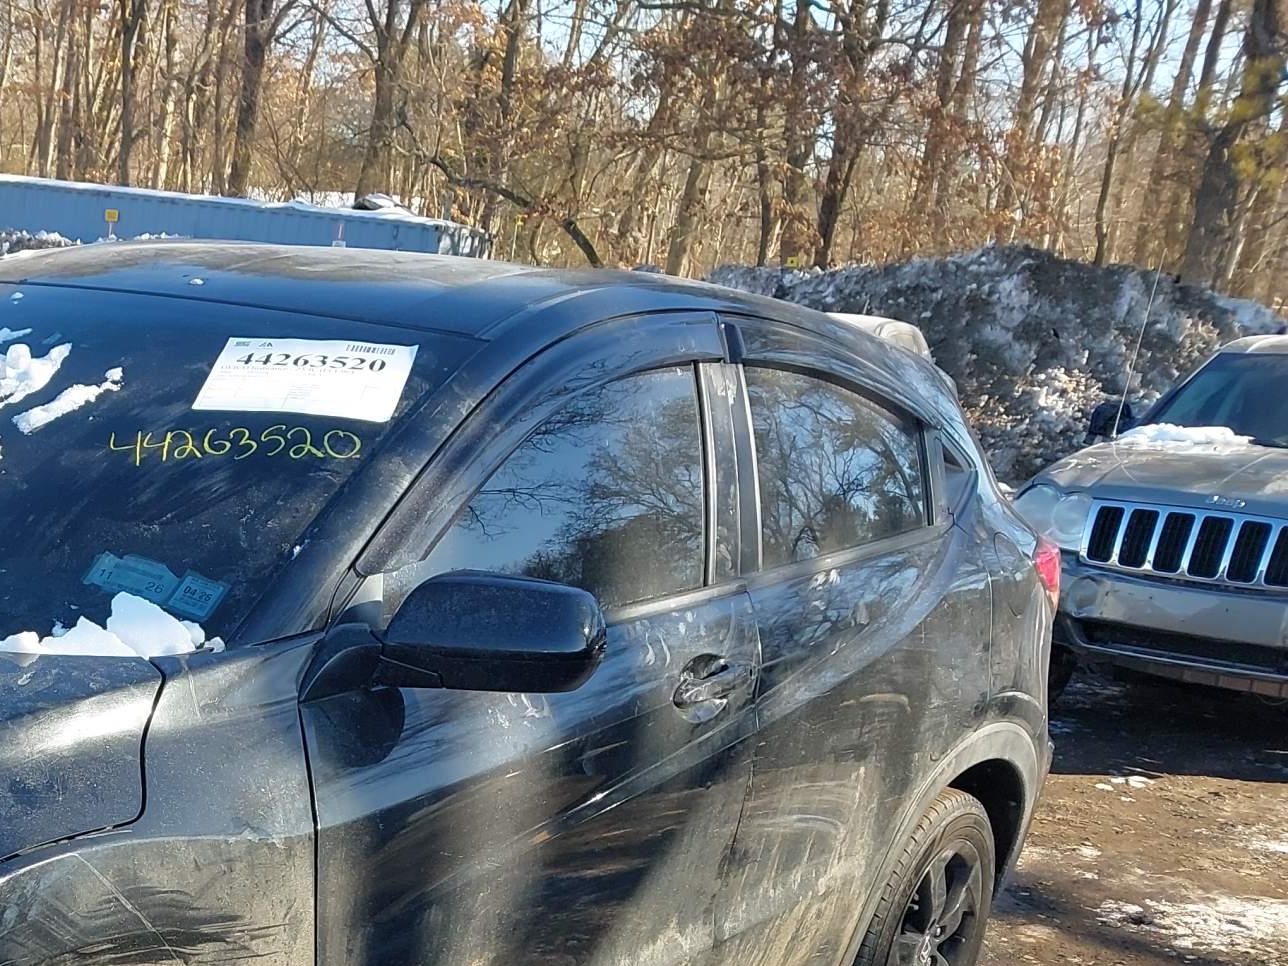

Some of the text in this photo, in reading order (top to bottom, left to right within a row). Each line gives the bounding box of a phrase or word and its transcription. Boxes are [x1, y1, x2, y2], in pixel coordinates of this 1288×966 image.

[236, 352, 387, 373] 44263520
[109, 424, 361, 466] 44263520
[145, 582, 165, 594] 26
